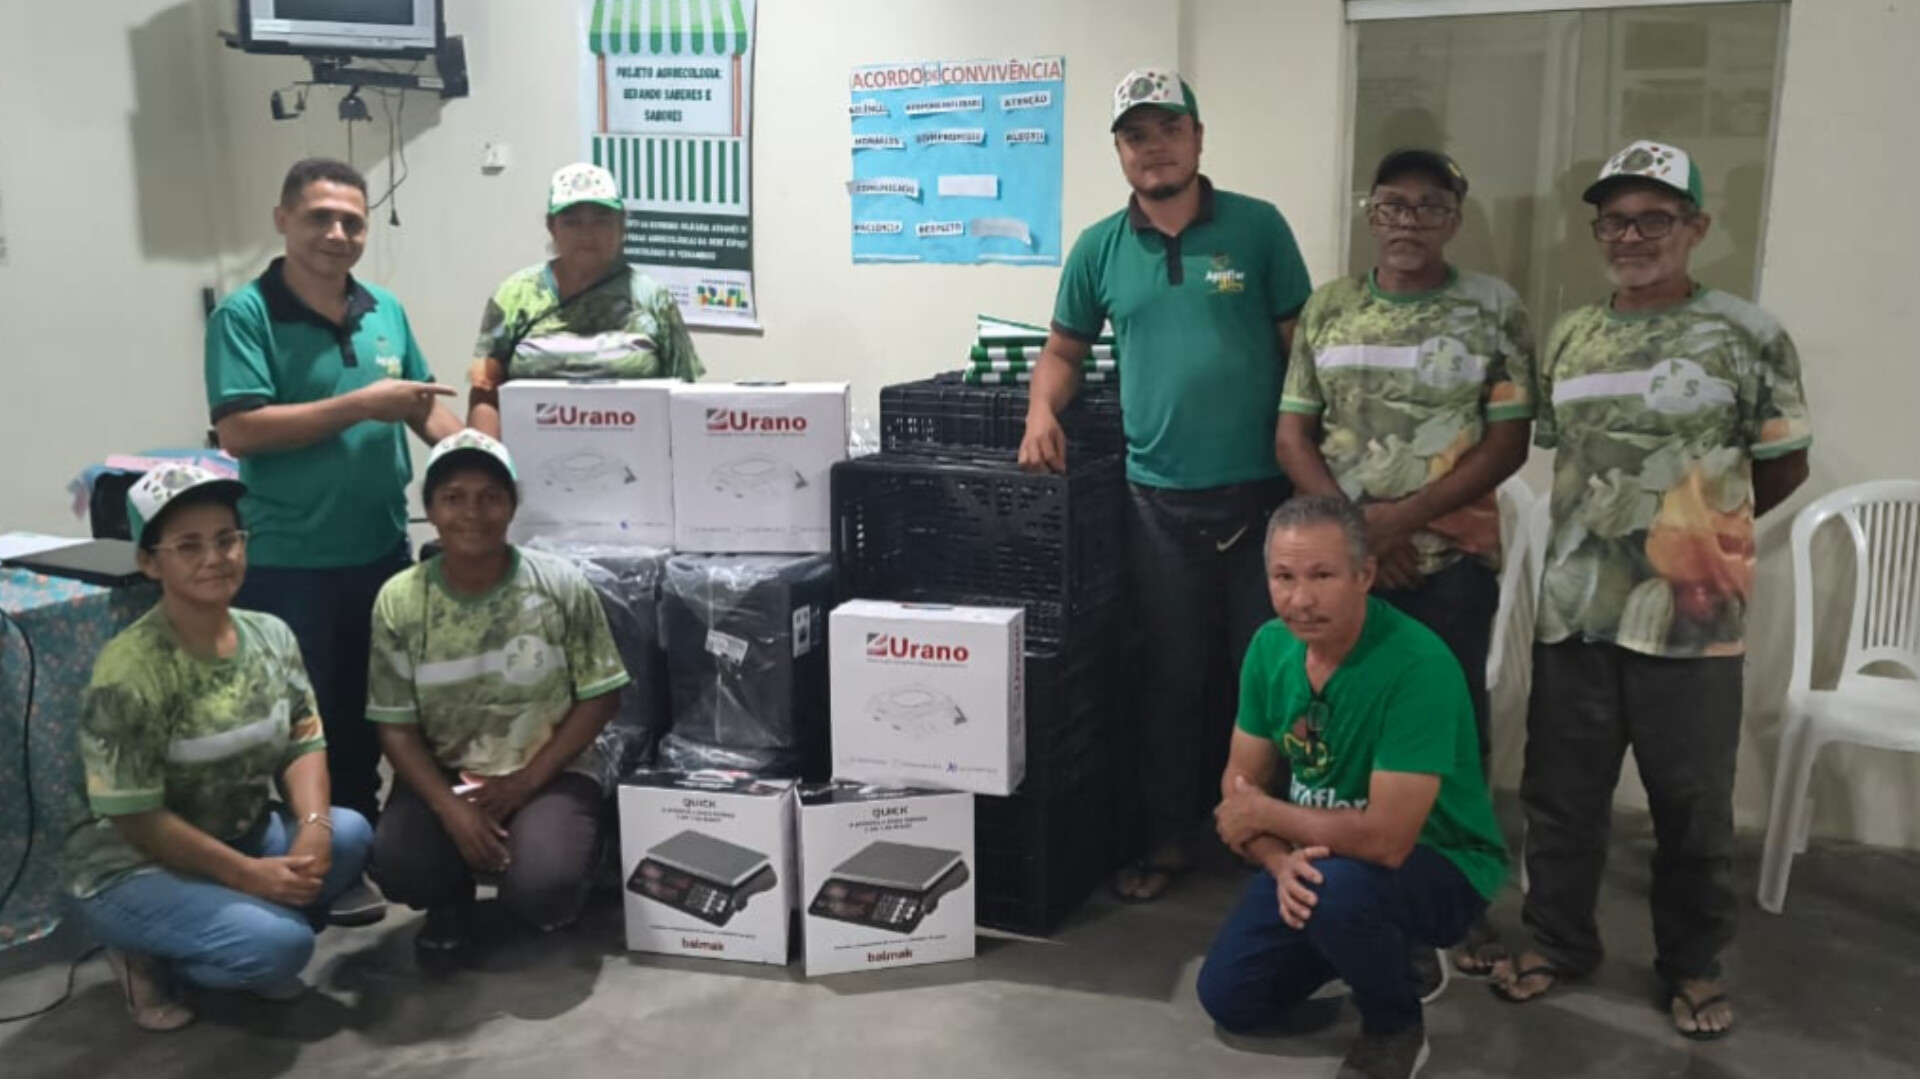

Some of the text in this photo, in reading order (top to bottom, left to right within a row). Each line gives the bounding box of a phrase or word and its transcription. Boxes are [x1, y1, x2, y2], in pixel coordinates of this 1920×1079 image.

[853, 68, 922, 88] ACORDO
[941, 58, 1061, 84] CONVIVÊNCIA
[558, 406, 636, 428] Urano
[729, 408, 807, 431] Urano
[889, 637, 970, 662] Urano
[872, 806, 908, 819] QUICK
